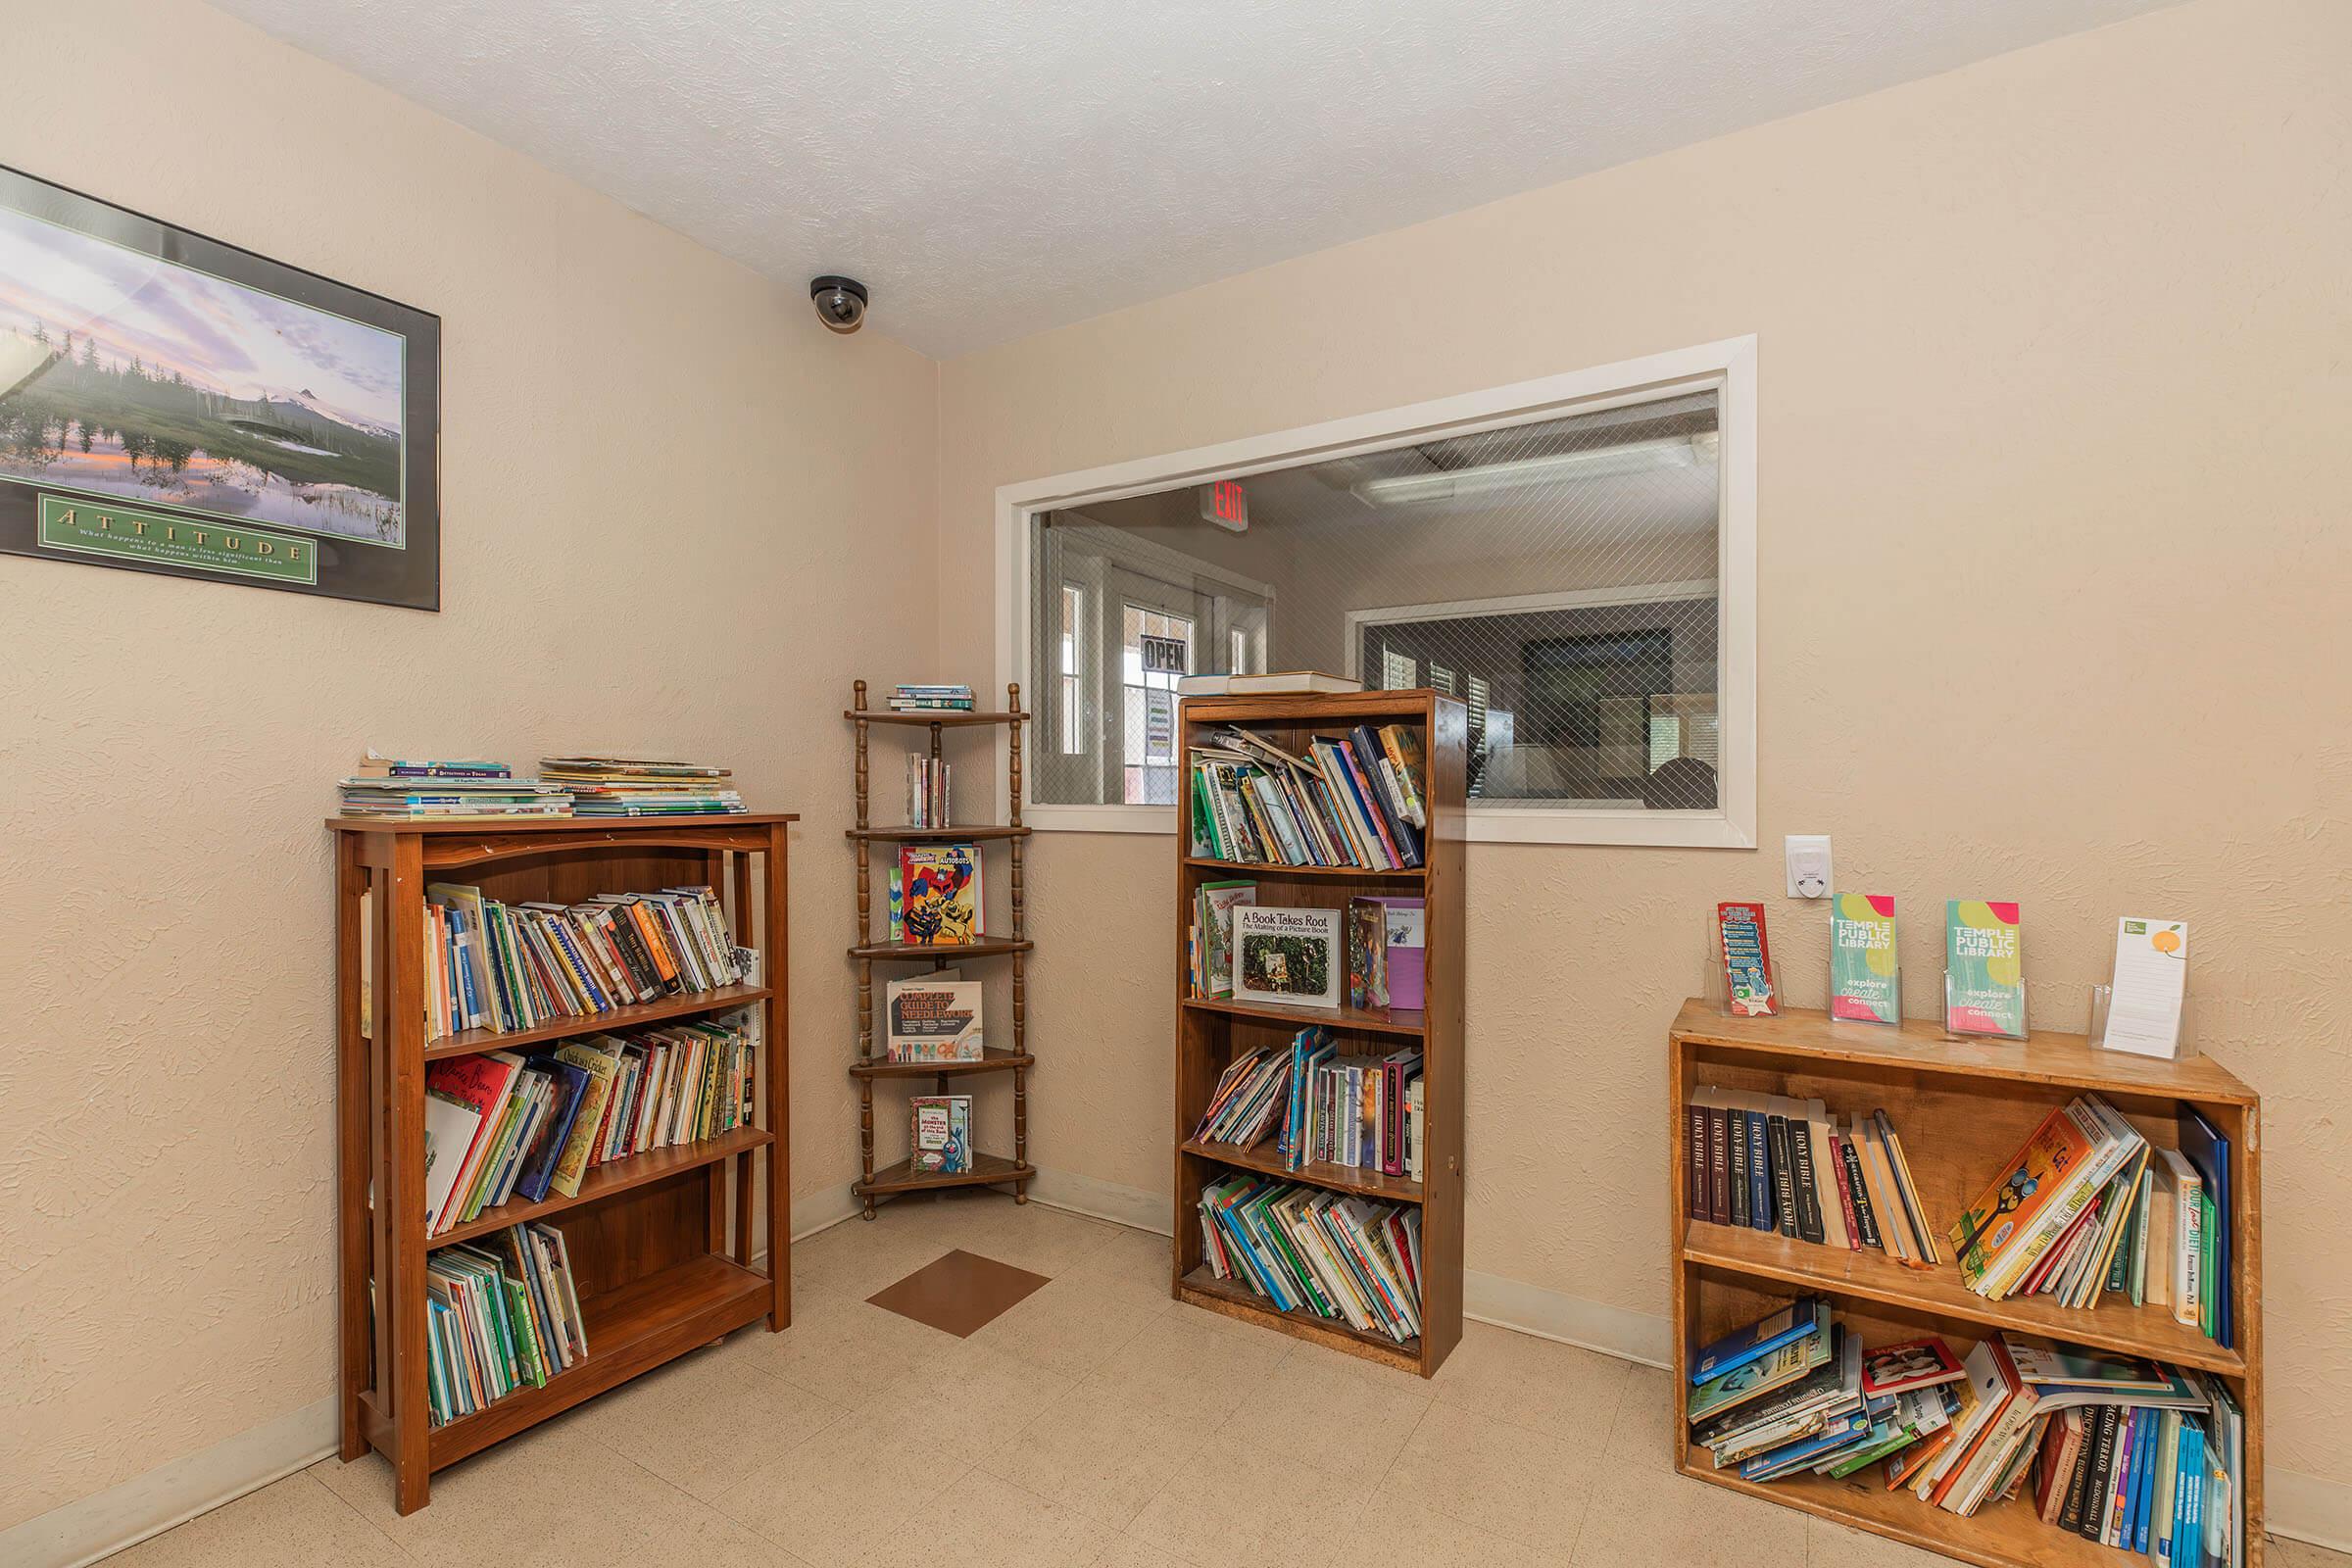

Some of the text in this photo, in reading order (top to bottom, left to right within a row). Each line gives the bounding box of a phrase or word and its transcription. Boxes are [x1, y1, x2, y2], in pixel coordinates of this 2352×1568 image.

[1215, 480, 1243, 525] EXIT
[57, 509, 300, 561] ATTITUDE
[79, 529, 104, 538] What
[107, 533, 144, 544] happens
[218, 550, 262, 562] significant
[129, 543, 241, 564] what happens within him.
[1145, 640, 1185, 671] OPEN
[1243, 911, 1329, 927] A Book Takes Root
[1838, 919, 1890, 931] TEMPLE
[1254, 923, 1276, 932] Making
[1289, 925, 1311, 934] Picture
[1839, 929, 1889, 941] PUBLIC
[1954, 926, 2015, 940] TEMPLE
[1838, 939, 1889, 950] LIBRARY
[1956, 937, 2015, 951] PUBLIC
[1956, 947, 2014, 958] LIBRARY
[1847, 979, 1888, 990] explore
[900, 992, 956, 1001] COMPLETE
[1840, 987, 1882, 1001] create
[1967, 990, 2010, 1000] explore
[900, 1001, 950, 1010] GUIDE TO
[1848, 998, 1888, 1008] connect
[1959, 998, 2004, 1011] create
[901, 1009, 973, 1020] NEEDLEWORK
[1967, 1007, 2014, 1019] connect
[588, 1054, 608, 1075] Cricket
[1691, 1114, 1704, 1169] HOLY BIBLE
[1712, 1117, 1724, 1172] HOLY BIBLE
[1731, 1118, 1744, 1174] HOLY BIBLE
[1750, 1121, 1765, 1177] HOLY BIBLE
[1793, 1129, 1812, 1189] HOLY BIBLE
[1778, 1168, 1793, 1226] HOLY BIBLE
[2187, 1184, 2200, 1251] YOUR Last DIET!
[2082, 1405, 2095, 1456] DISCRETION
[2096, 1437, 2110, 1475] TERROR
[2075, 1455, 2087, 1493] ELIZABETH
